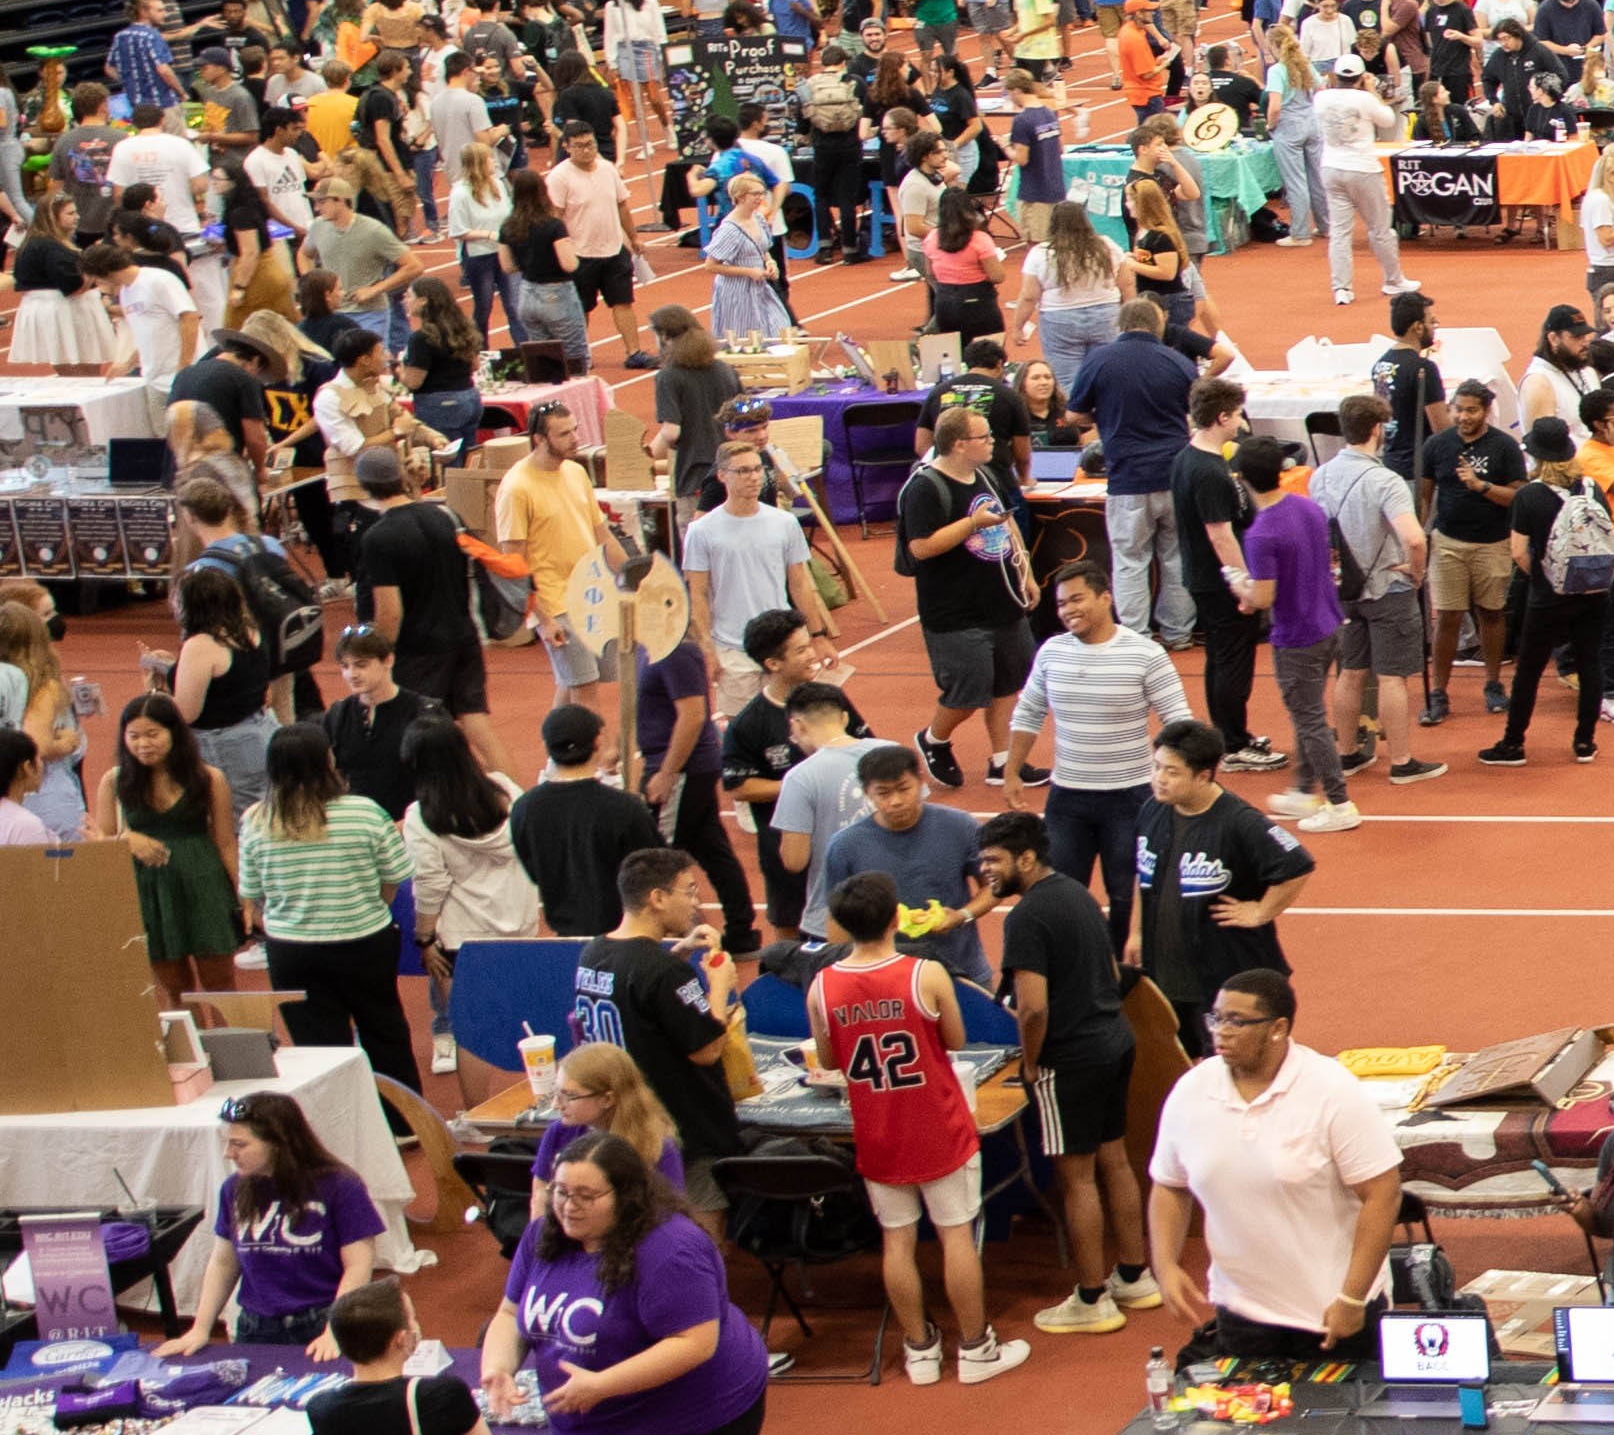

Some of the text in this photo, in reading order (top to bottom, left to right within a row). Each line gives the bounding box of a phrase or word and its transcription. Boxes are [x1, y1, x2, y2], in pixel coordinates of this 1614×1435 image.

[729, 38, 775, 60] Proof
[725, 60, 780, 78] Purchase
[1397, 160, 1421, 170] RIT
[834, 999, 905, 1027] VALOR
[849, 1029, 927, 1090] 42
